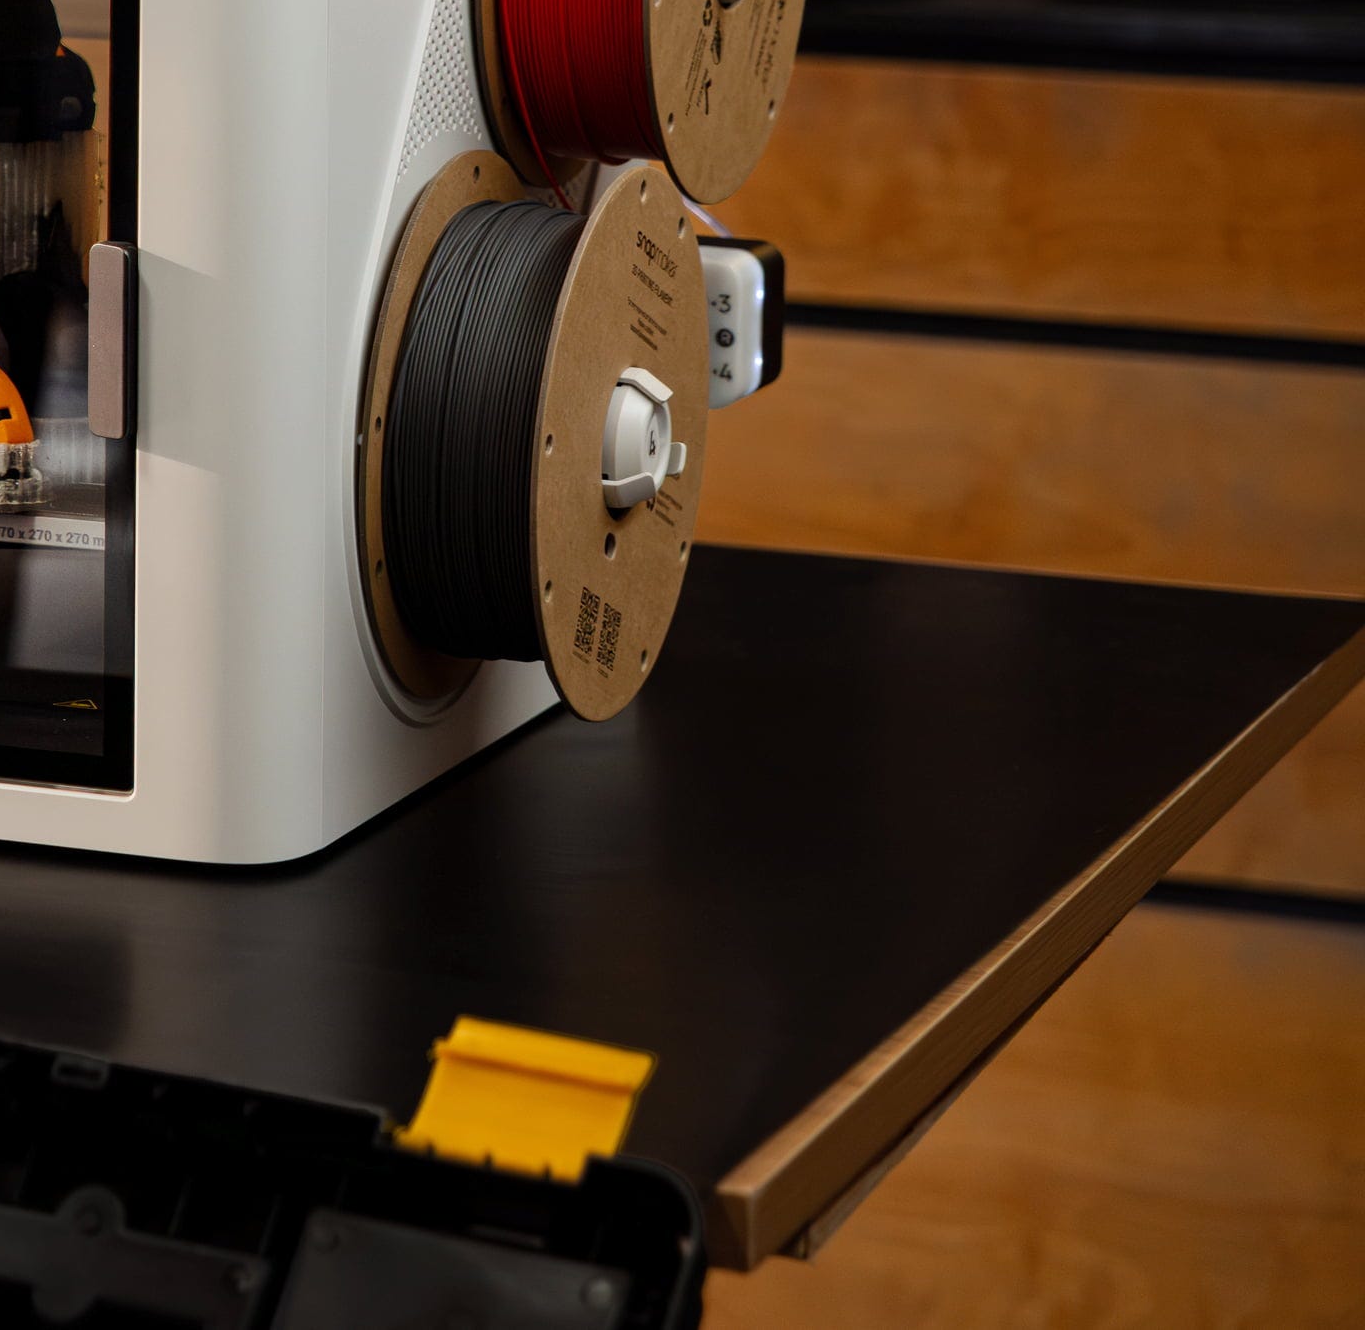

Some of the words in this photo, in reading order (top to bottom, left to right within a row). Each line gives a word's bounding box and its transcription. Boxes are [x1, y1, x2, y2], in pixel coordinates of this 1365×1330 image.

[717, 293, 732, 314] 3
[18, 530, 25, 539] x
[29, 528, 52, 542] 270
[56, 533, 62, 542] x
[66, 532, 89, 545] 270
